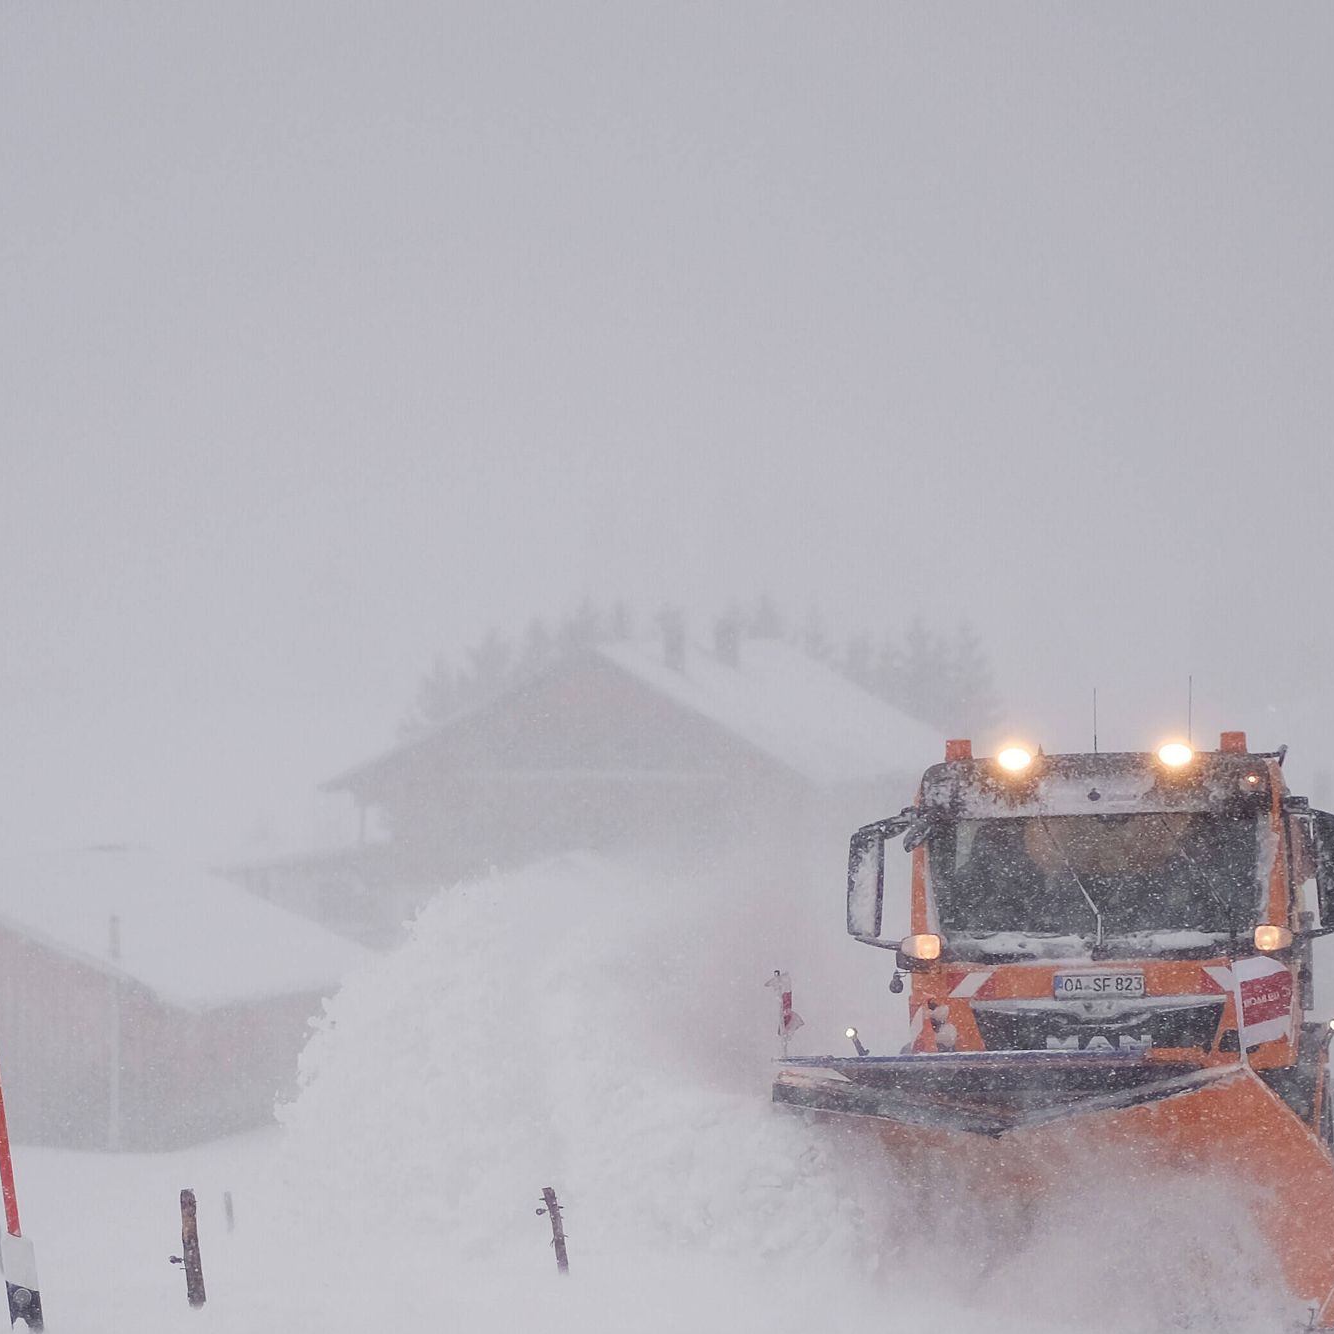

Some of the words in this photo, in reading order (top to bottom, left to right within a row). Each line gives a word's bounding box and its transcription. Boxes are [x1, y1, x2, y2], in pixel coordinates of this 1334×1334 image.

[1064, 978, 1083, 992] OA
[1093, 977, 1111, 992] SF
[1115, 977, 1143, 991] 823
[1046, 1034, 1152, 1053] MAN
